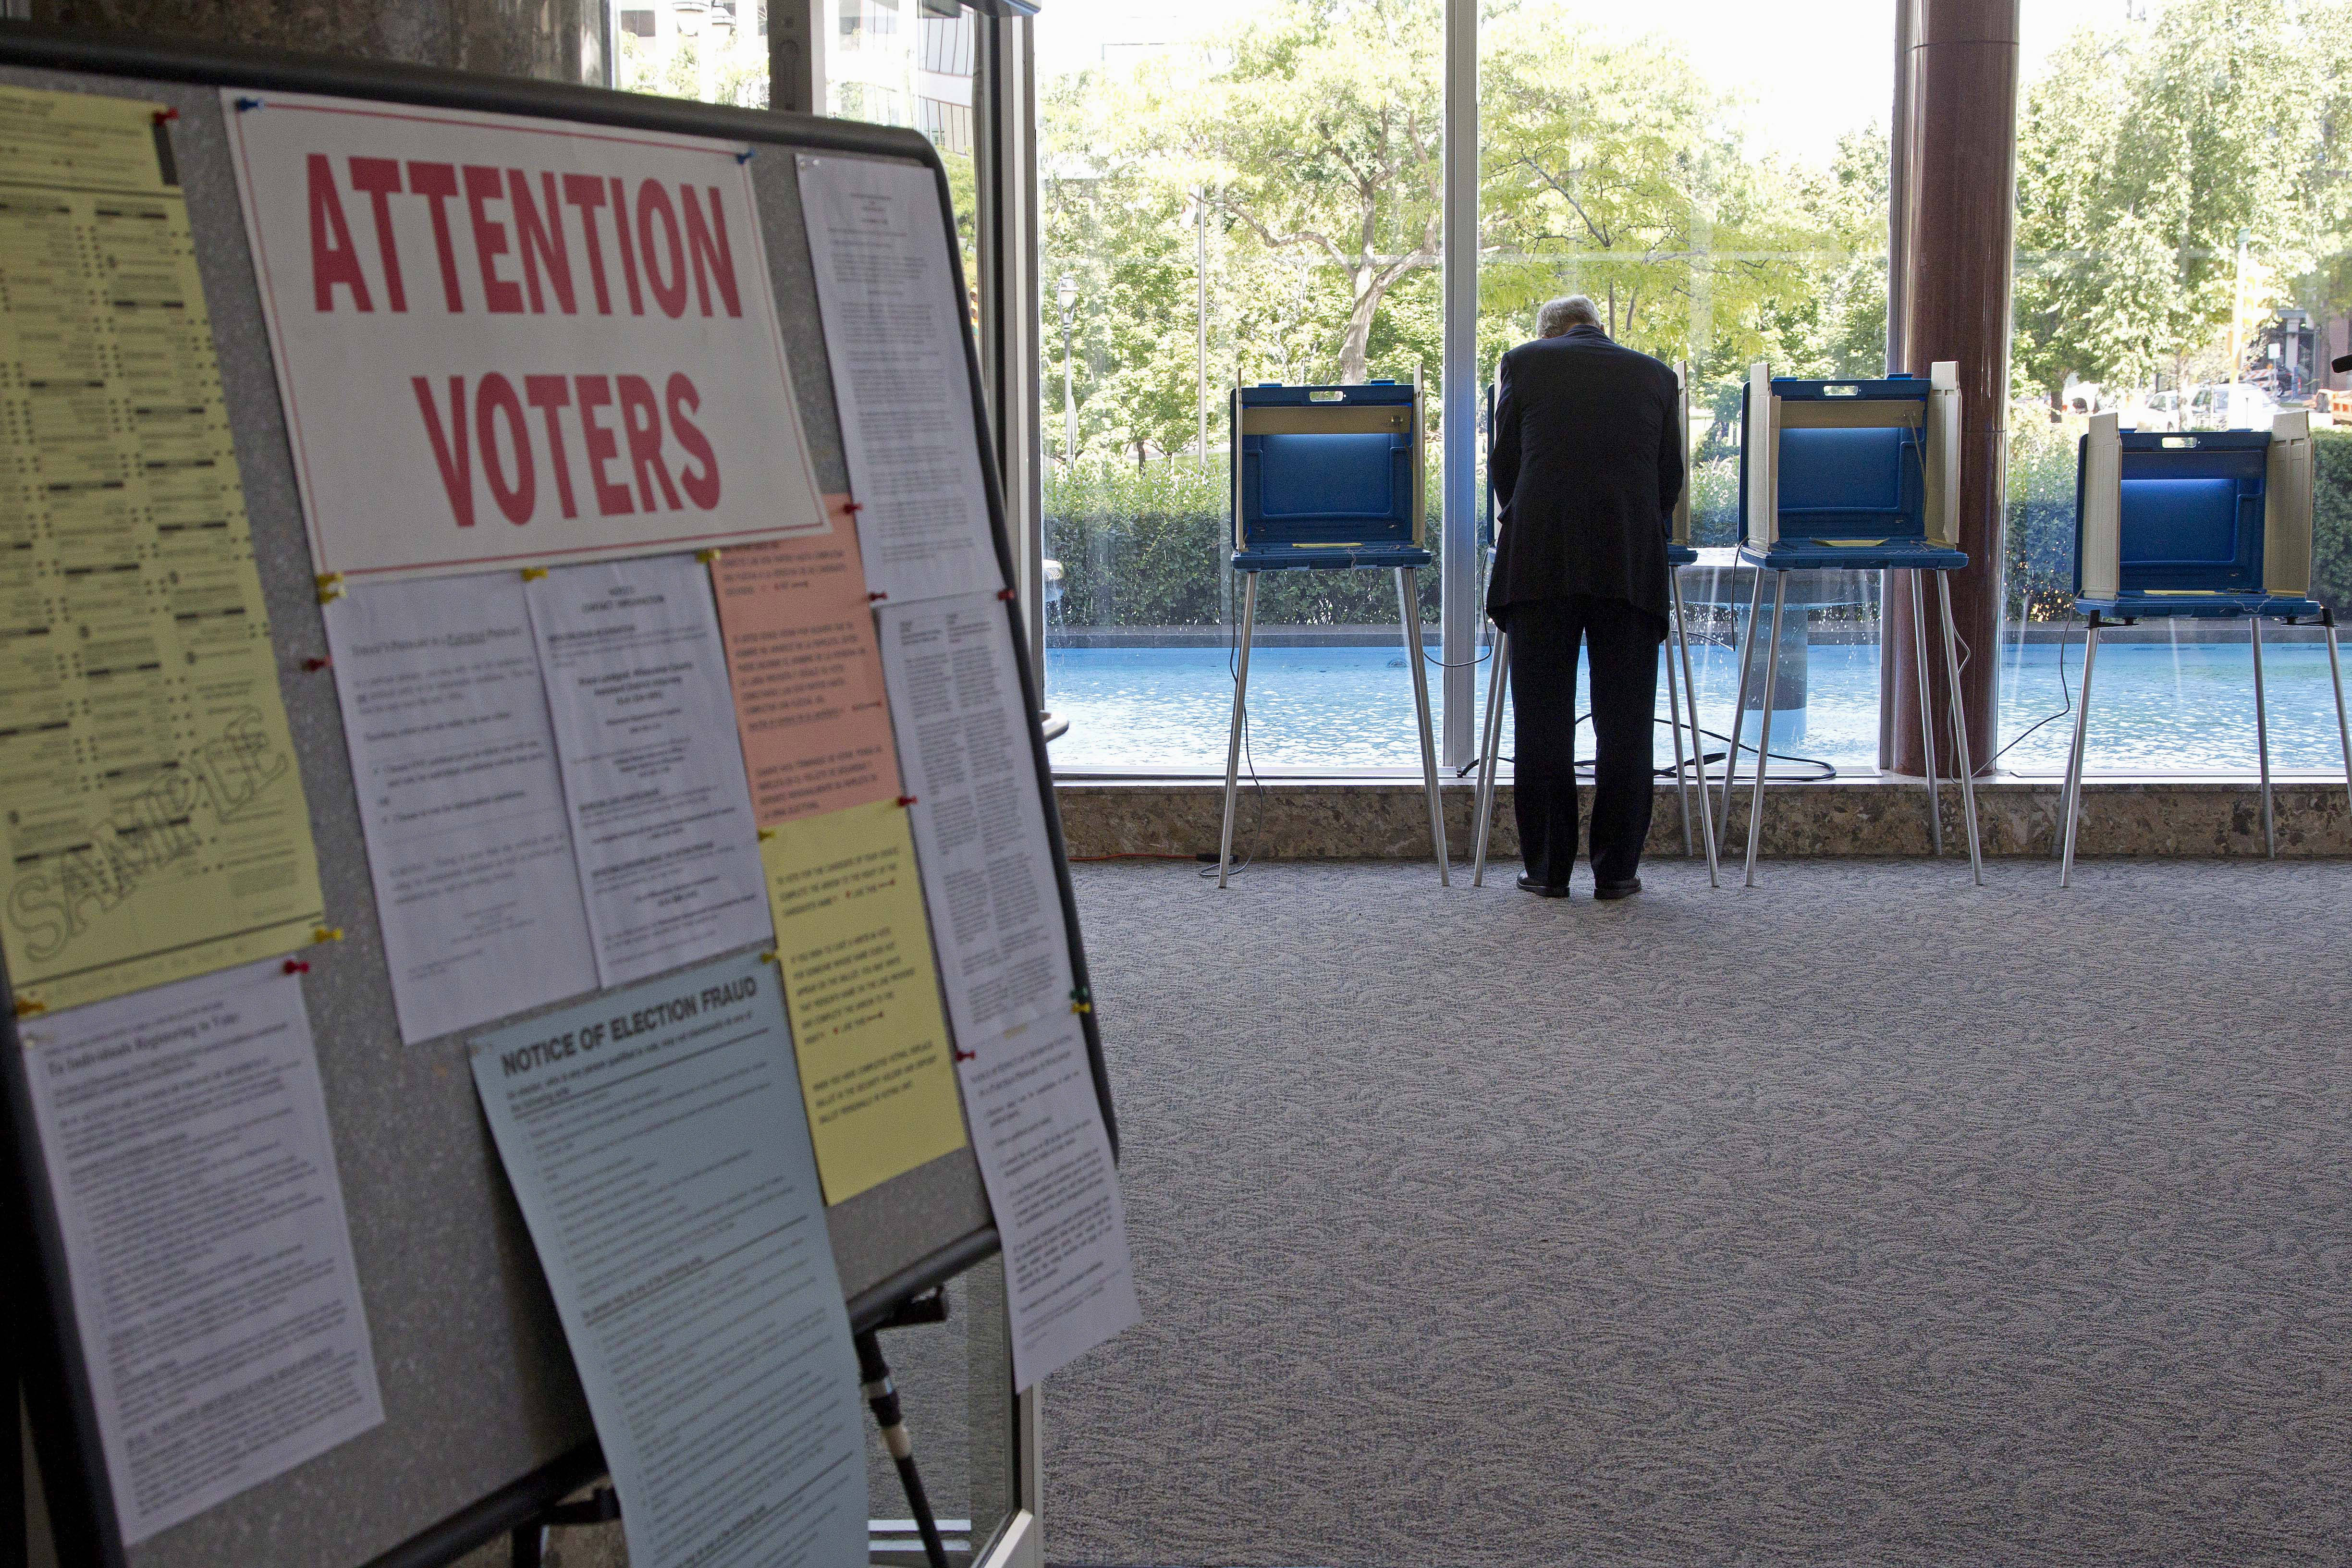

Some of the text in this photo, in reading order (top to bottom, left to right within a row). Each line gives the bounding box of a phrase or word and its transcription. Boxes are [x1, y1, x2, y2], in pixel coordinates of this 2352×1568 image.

[308, 154, 741, 318] ATTENTION
[412, 373, 720, 527] VOTERS
[7, 703, 289, 962] SAMPLE
[501, 977, 758, 1077] NOTICE OF ELECTION FRAUD
